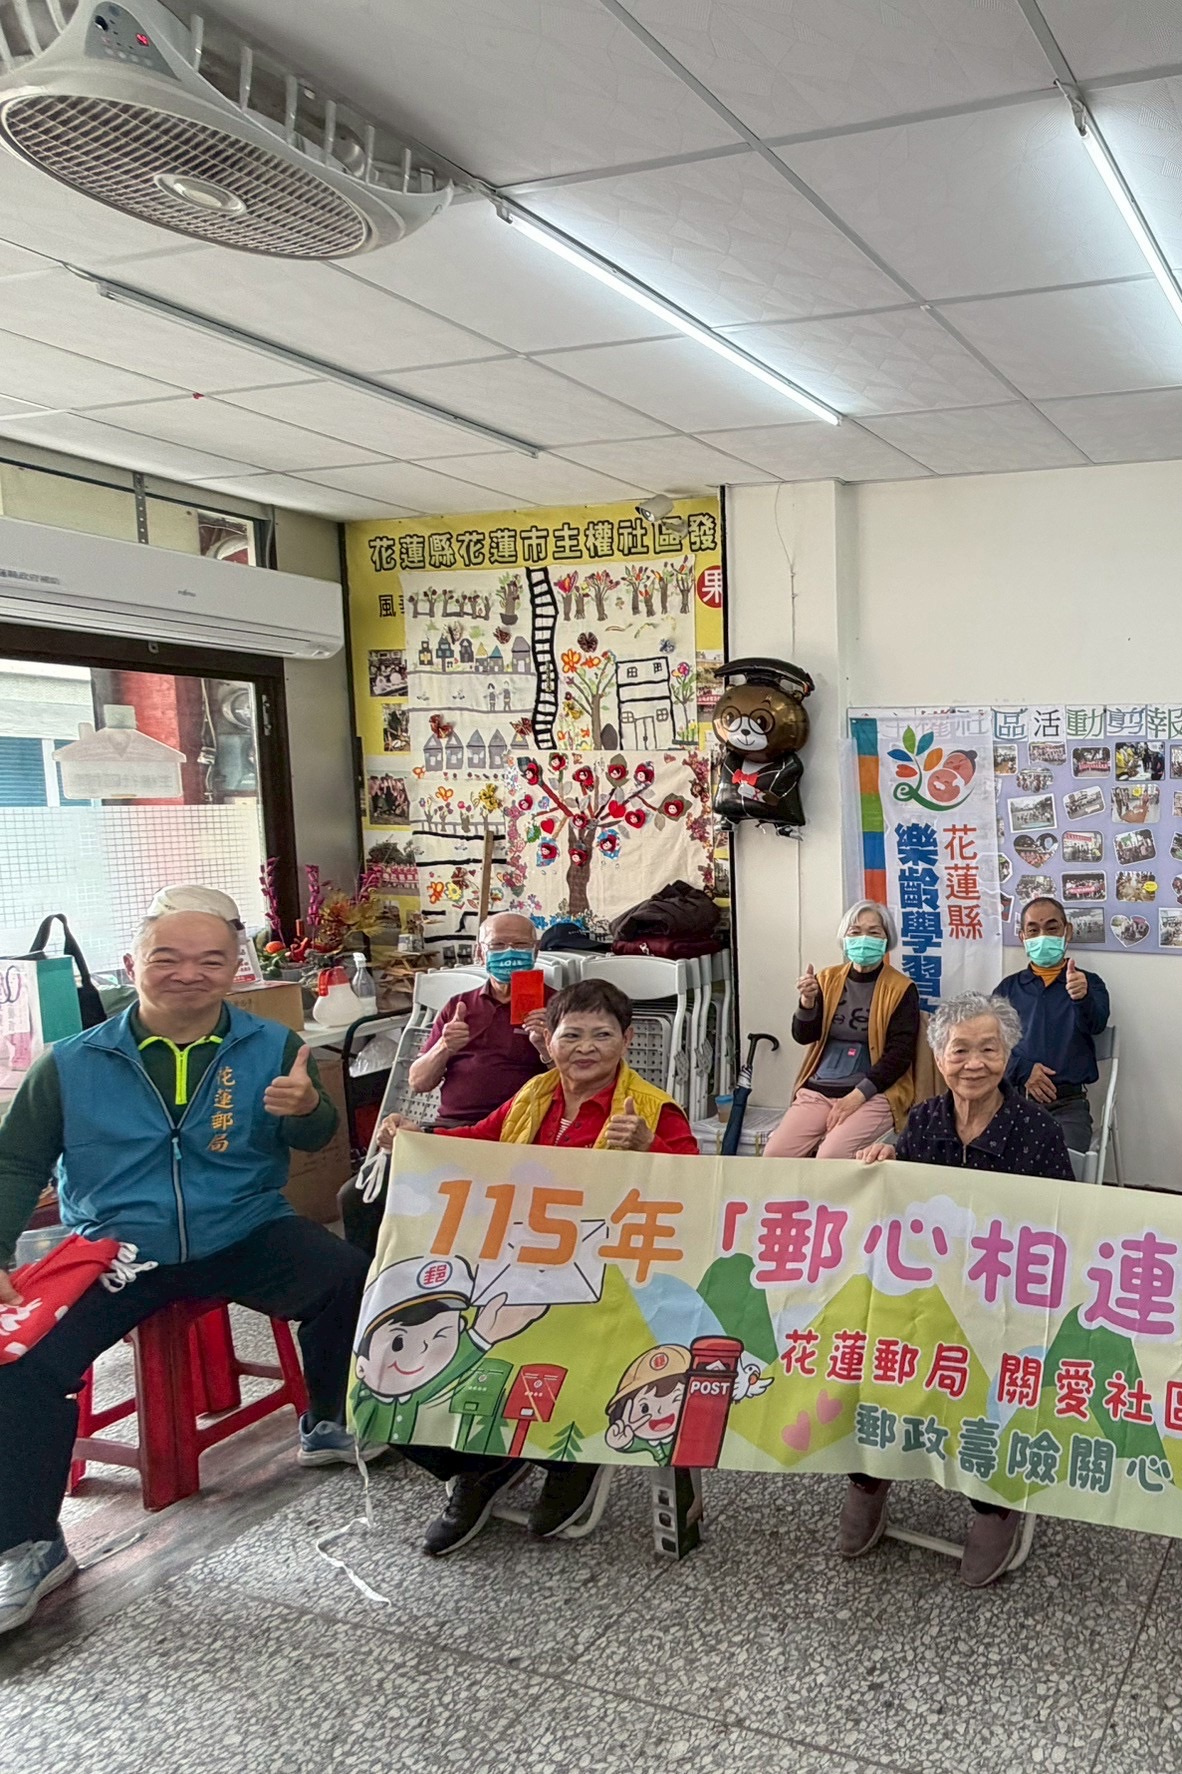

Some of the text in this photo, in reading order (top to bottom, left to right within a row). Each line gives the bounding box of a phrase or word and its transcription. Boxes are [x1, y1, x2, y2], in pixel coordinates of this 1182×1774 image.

[378, 594, 404, 618] 風
[894, 822, 943, 1013] 樂齡學習
[943, 824, 984, 940] 花蓮縣
[206, 1065, 236, 1153] 花蓮郵局
[689, 1380, 731, 1396] POST
[780, 1329, 969, 1398] 花蓮郵局
